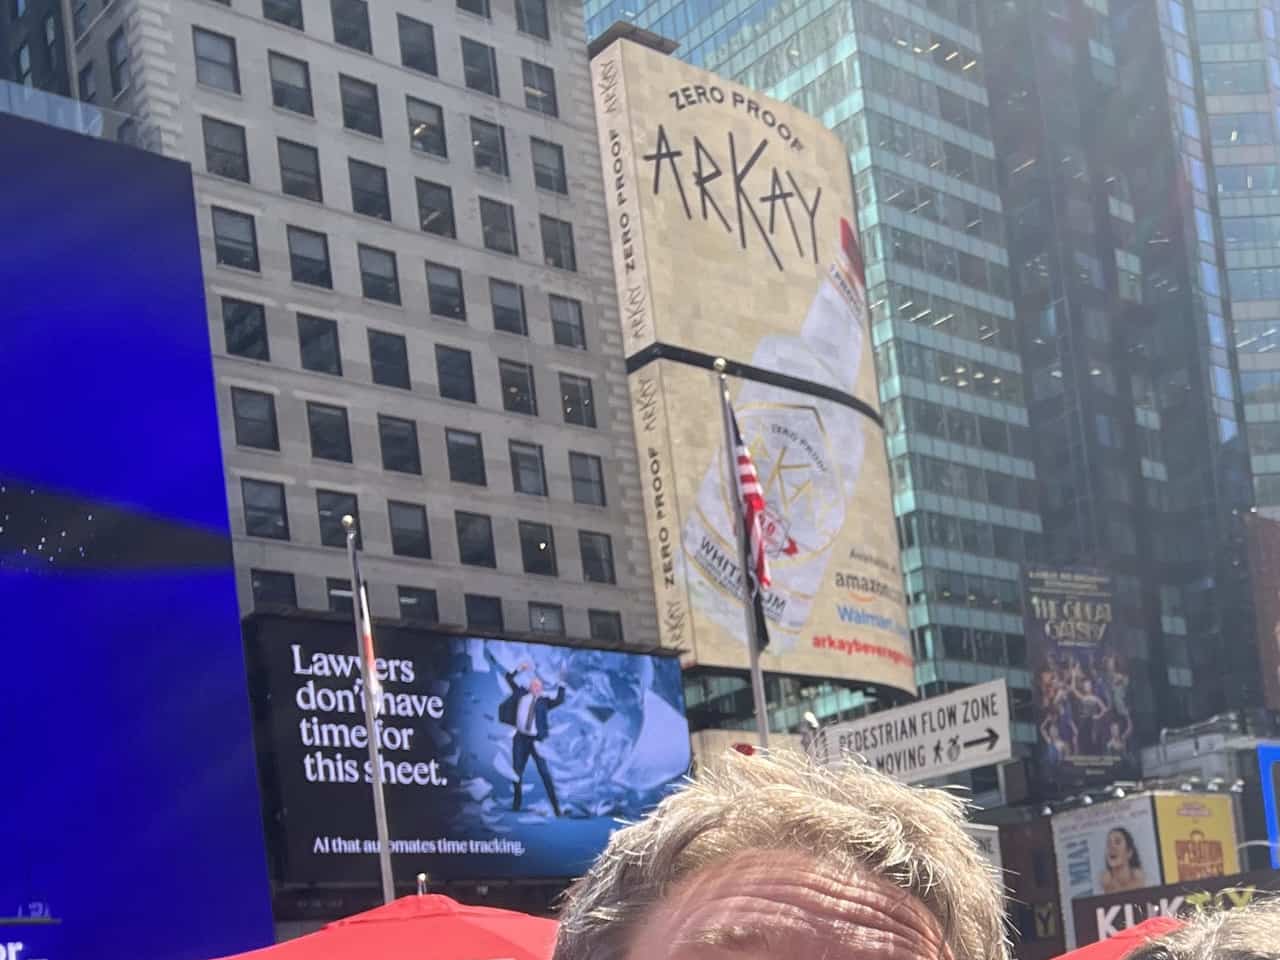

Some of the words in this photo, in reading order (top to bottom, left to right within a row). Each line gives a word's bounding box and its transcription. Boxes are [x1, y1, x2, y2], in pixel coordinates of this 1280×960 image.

[669, 84, 726, 112] ZERO
[731, 91, 806, 151] PROOF
[609, 129, 628, 207] PROOF
[642, 123, 823, 272] ARKAY
[619, 212, 636, 273] ZERO
[648, 447, 669, 521] PROOF
[659, 526, 676, 588] ZERO
[300, 716, 369, 748] time
[374, 719, 414, 751] for
[379, 690, 445, 719] have
[839, 717, 918, 753] PEDESTRIAN
[920, 705, 959, 737] FLOW
[962, 692, 999, 725] ZONE
[304, 751, 360, 783] this
[364, 753, 448, 786] sheet.
[313, 837, 330, 853] AI
[332, 837, 362, 853] that
[364, 838, 436, 854] auomates
[437, 838, 468, 853] time
